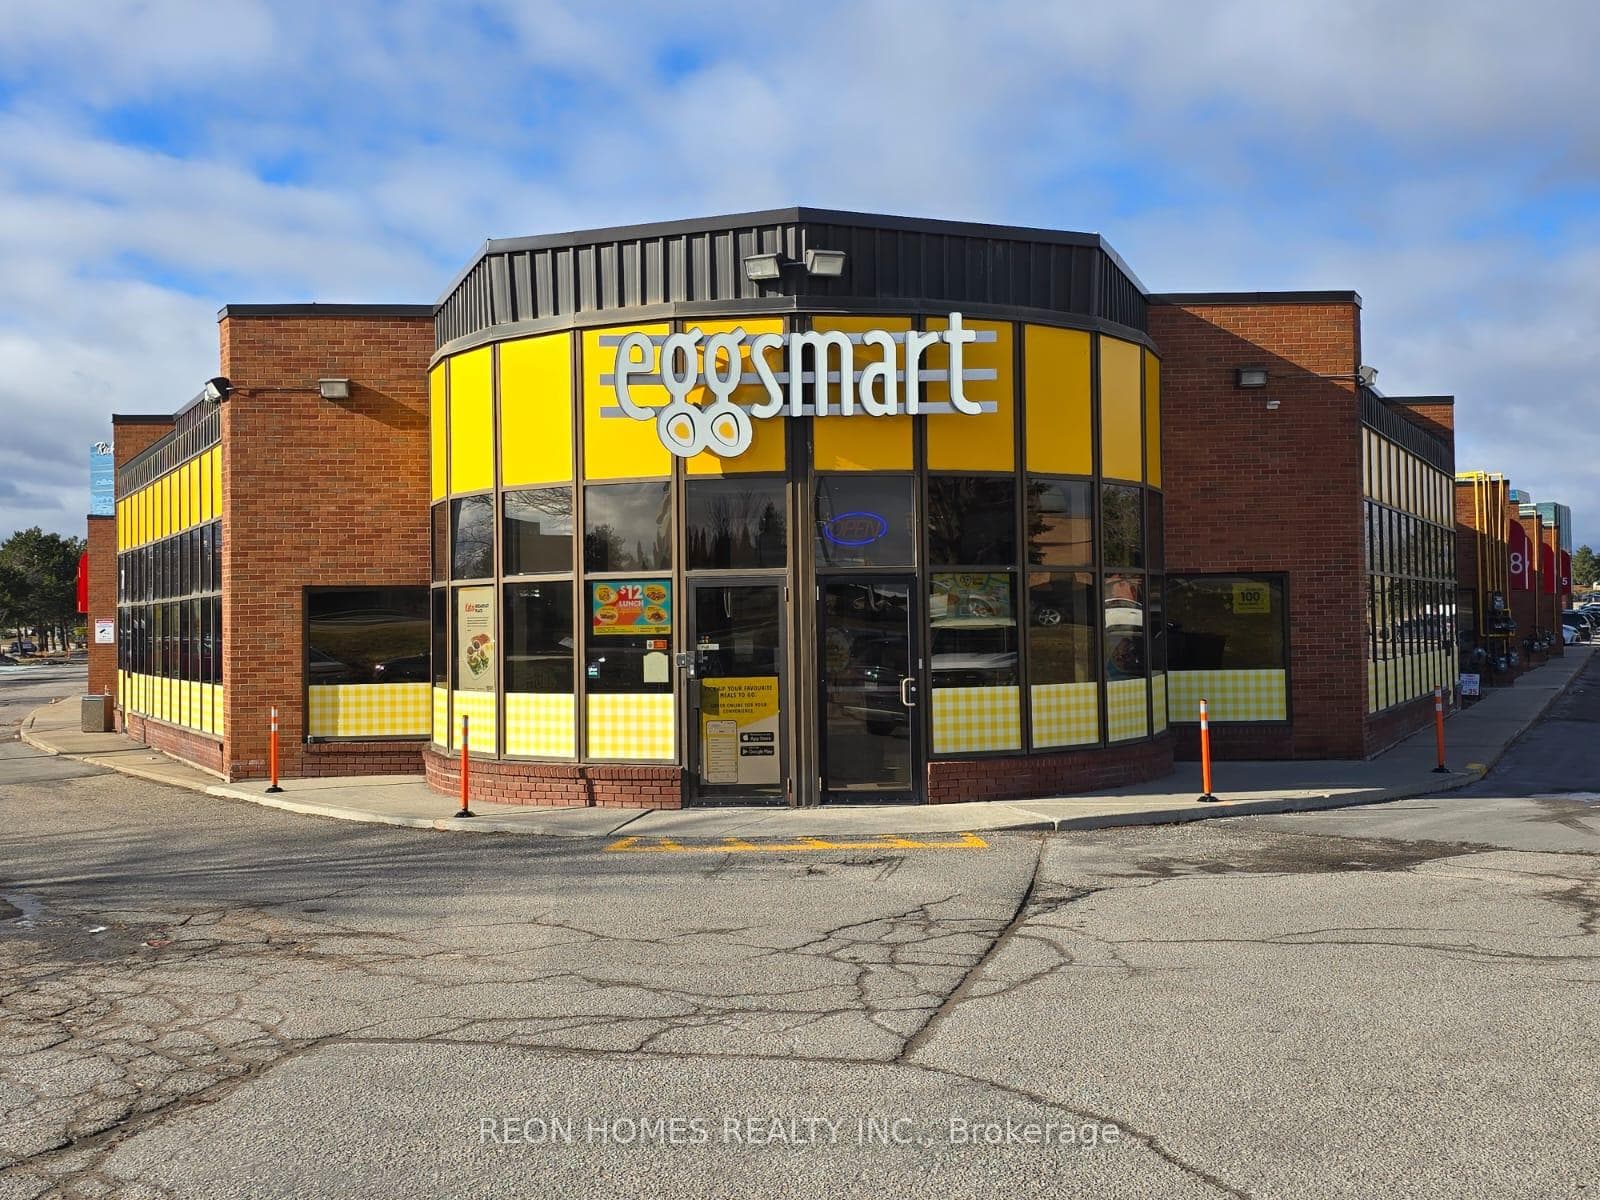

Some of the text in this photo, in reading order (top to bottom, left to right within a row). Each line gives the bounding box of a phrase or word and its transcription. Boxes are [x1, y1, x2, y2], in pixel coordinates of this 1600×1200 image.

[614, 312, 982, 458] eggsmart
[1510, 552, 1523, 574] 8
[619, 584, 644, 600] $12
[619, 599, 644, 608] LUNCH
